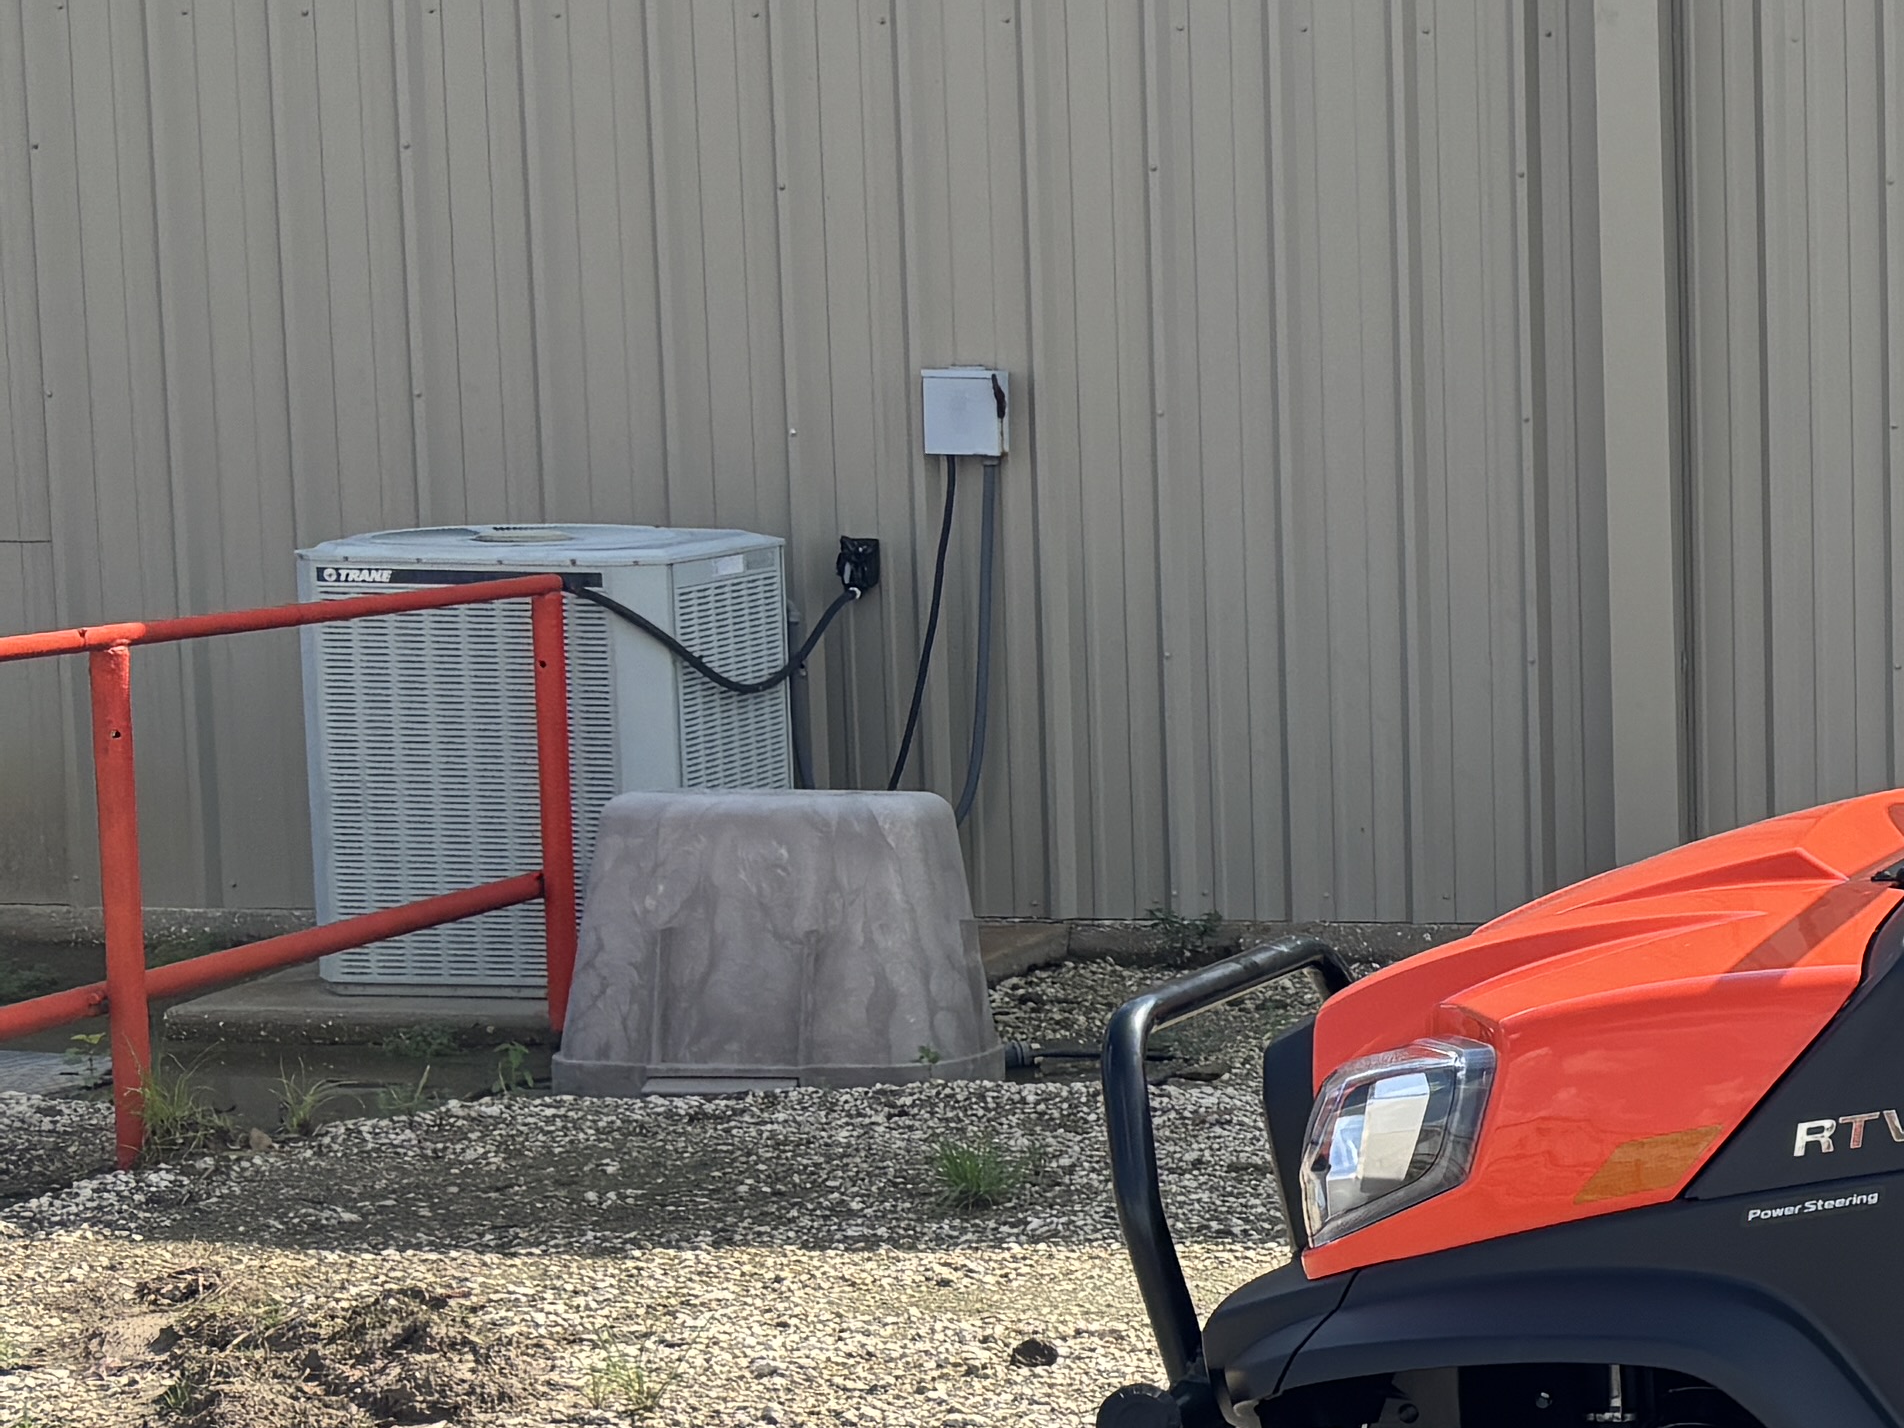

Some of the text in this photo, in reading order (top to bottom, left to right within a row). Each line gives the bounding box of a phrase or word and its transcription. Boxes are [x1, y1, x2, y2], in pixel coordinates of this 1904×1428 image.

[338, 569, 393, 583] TRANE
[1747, 1192, 1879, 1222] Power Steering
